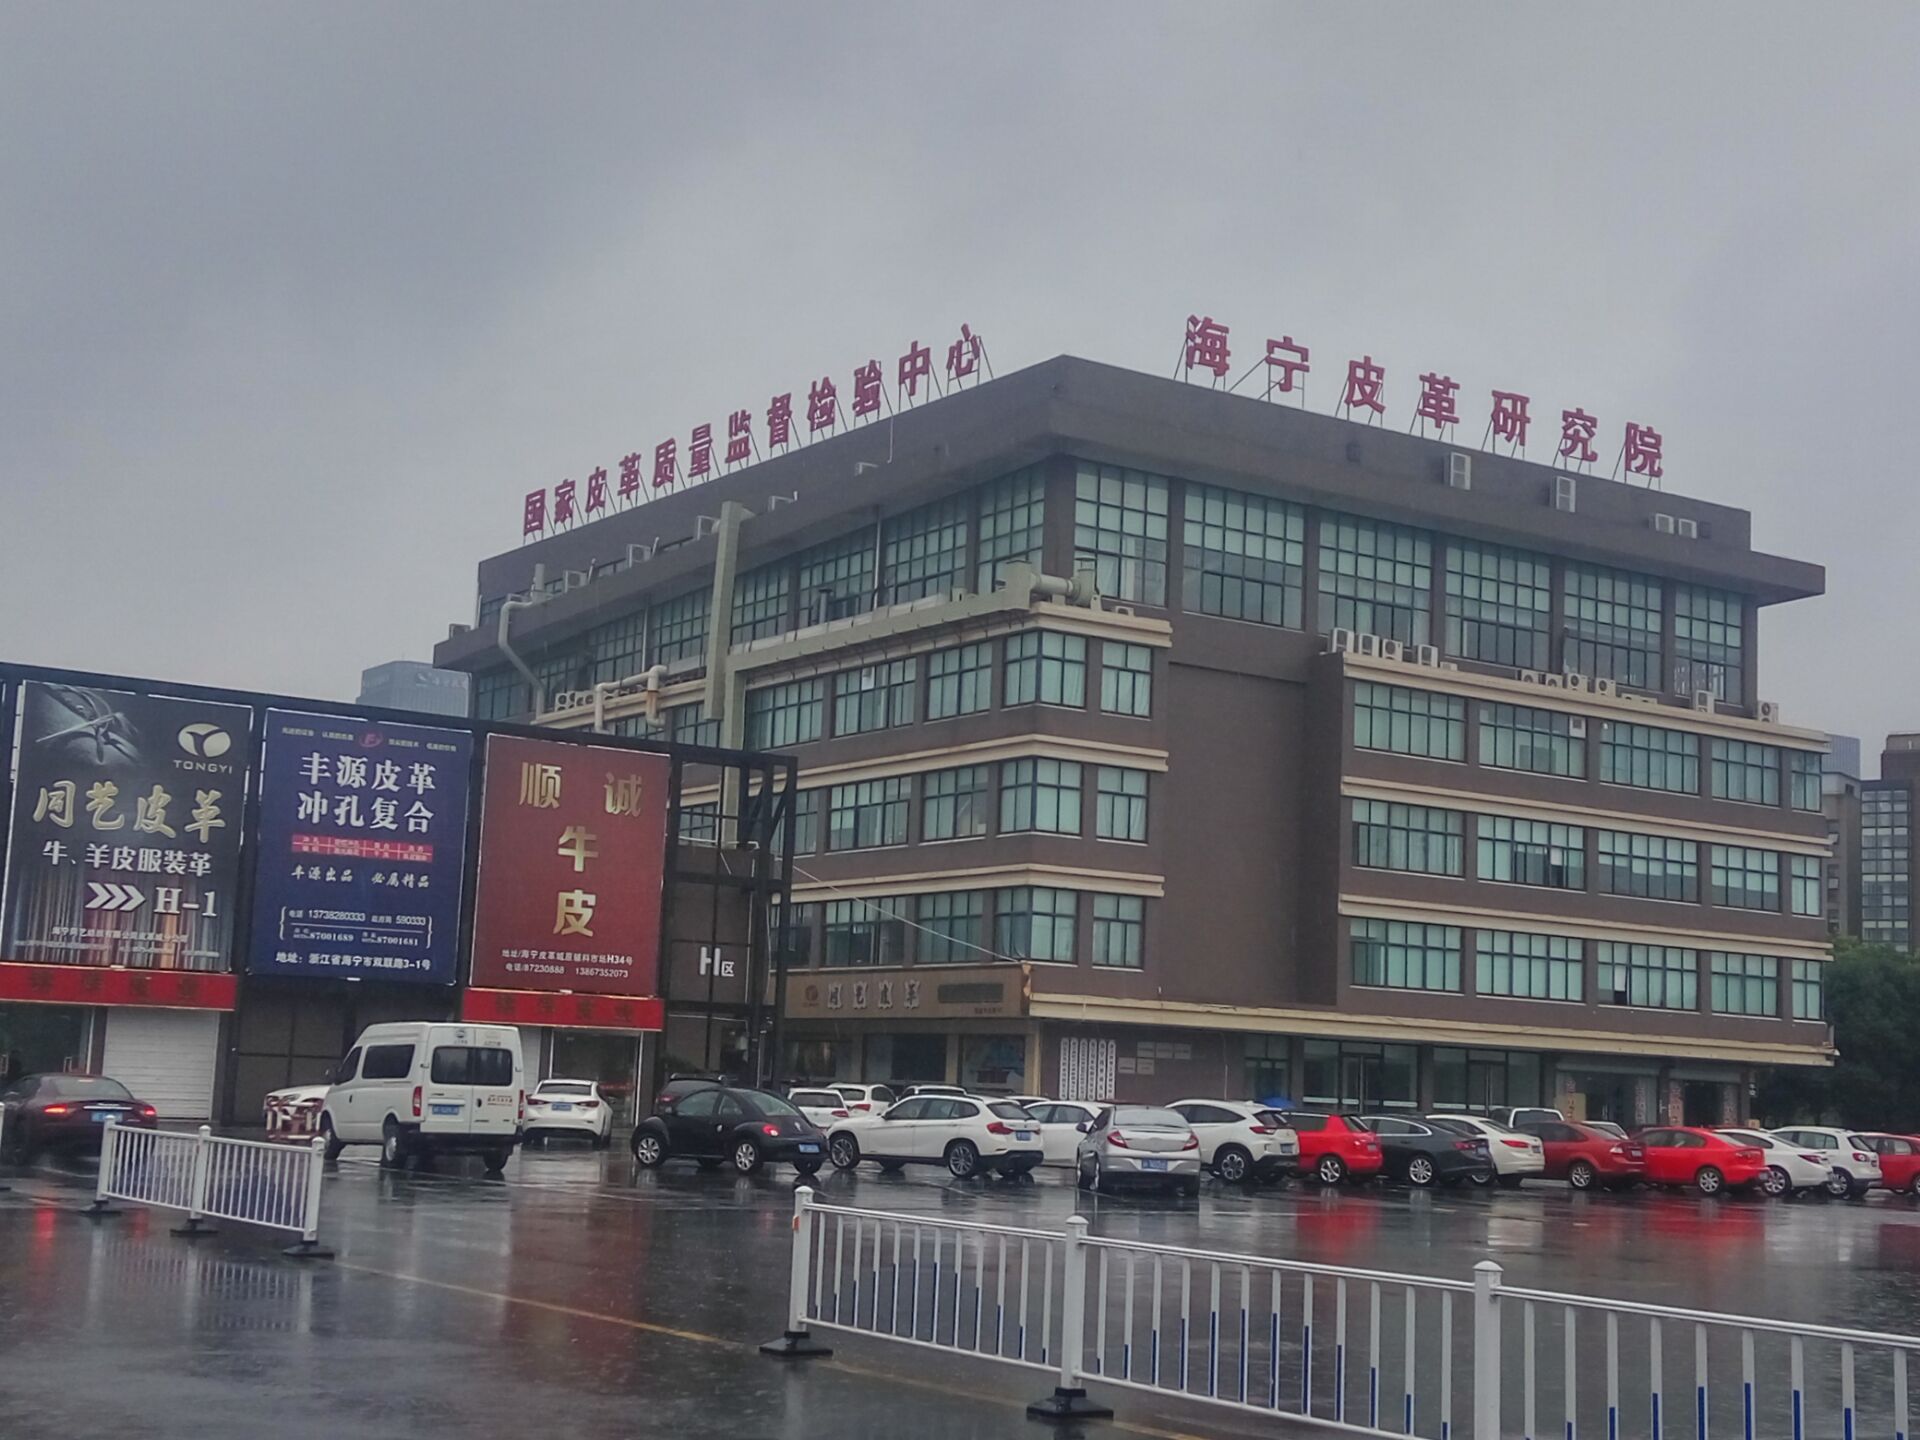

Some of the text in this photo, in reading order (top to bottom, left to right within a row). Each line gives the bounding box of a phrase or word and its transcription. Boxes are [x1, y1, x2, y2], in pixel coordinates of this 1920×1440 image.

[1185, 315, 1663, 478] 海宁皮革研究院
[523, 324, 980, 535] 国家皮革质量监督检验中心
[173, 760, 233, 774] TONGYI
[298, 751, 436, 795] 丰源皮革
[33, 780, 226, 843] 同艺皮革
[297, 791, 435, 833] 冲孔复合
[42, 841, 213, 876] 牛、羊皮服装革
[371, 872, 430, 889] 必属精品
[154, 886, 218, 917] H-1
[699, 946, 735, 977] H区
